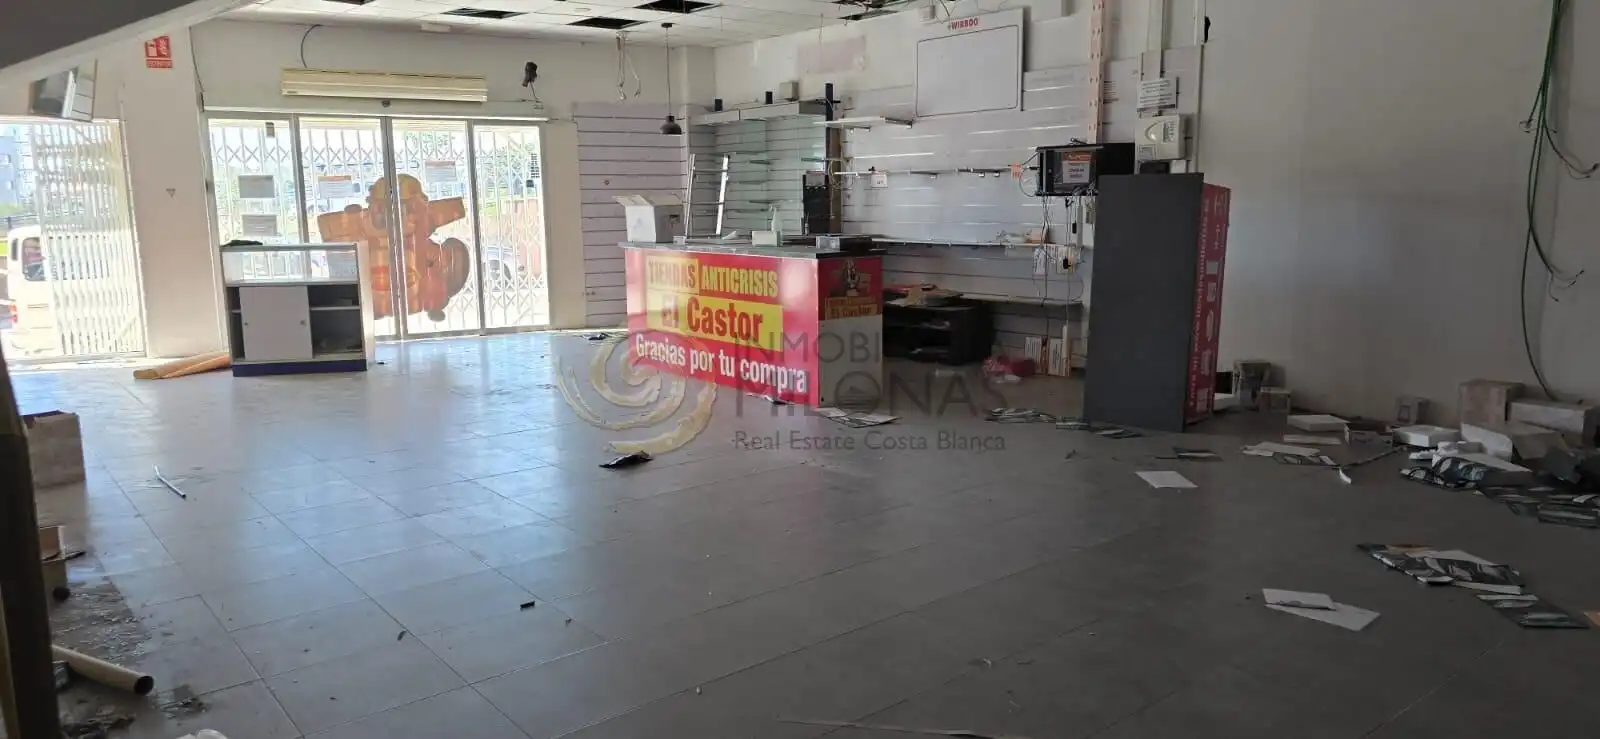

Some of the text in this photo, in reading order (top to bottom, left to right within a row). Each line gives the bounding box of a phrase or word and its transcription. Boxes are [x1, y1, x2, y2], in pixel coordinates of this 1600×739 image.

[701, 265, 778, 298] ANTICRISIS
[686, 297, 764, 342] Castor
[635, 333, 808, 394] Gracias por tu compra
